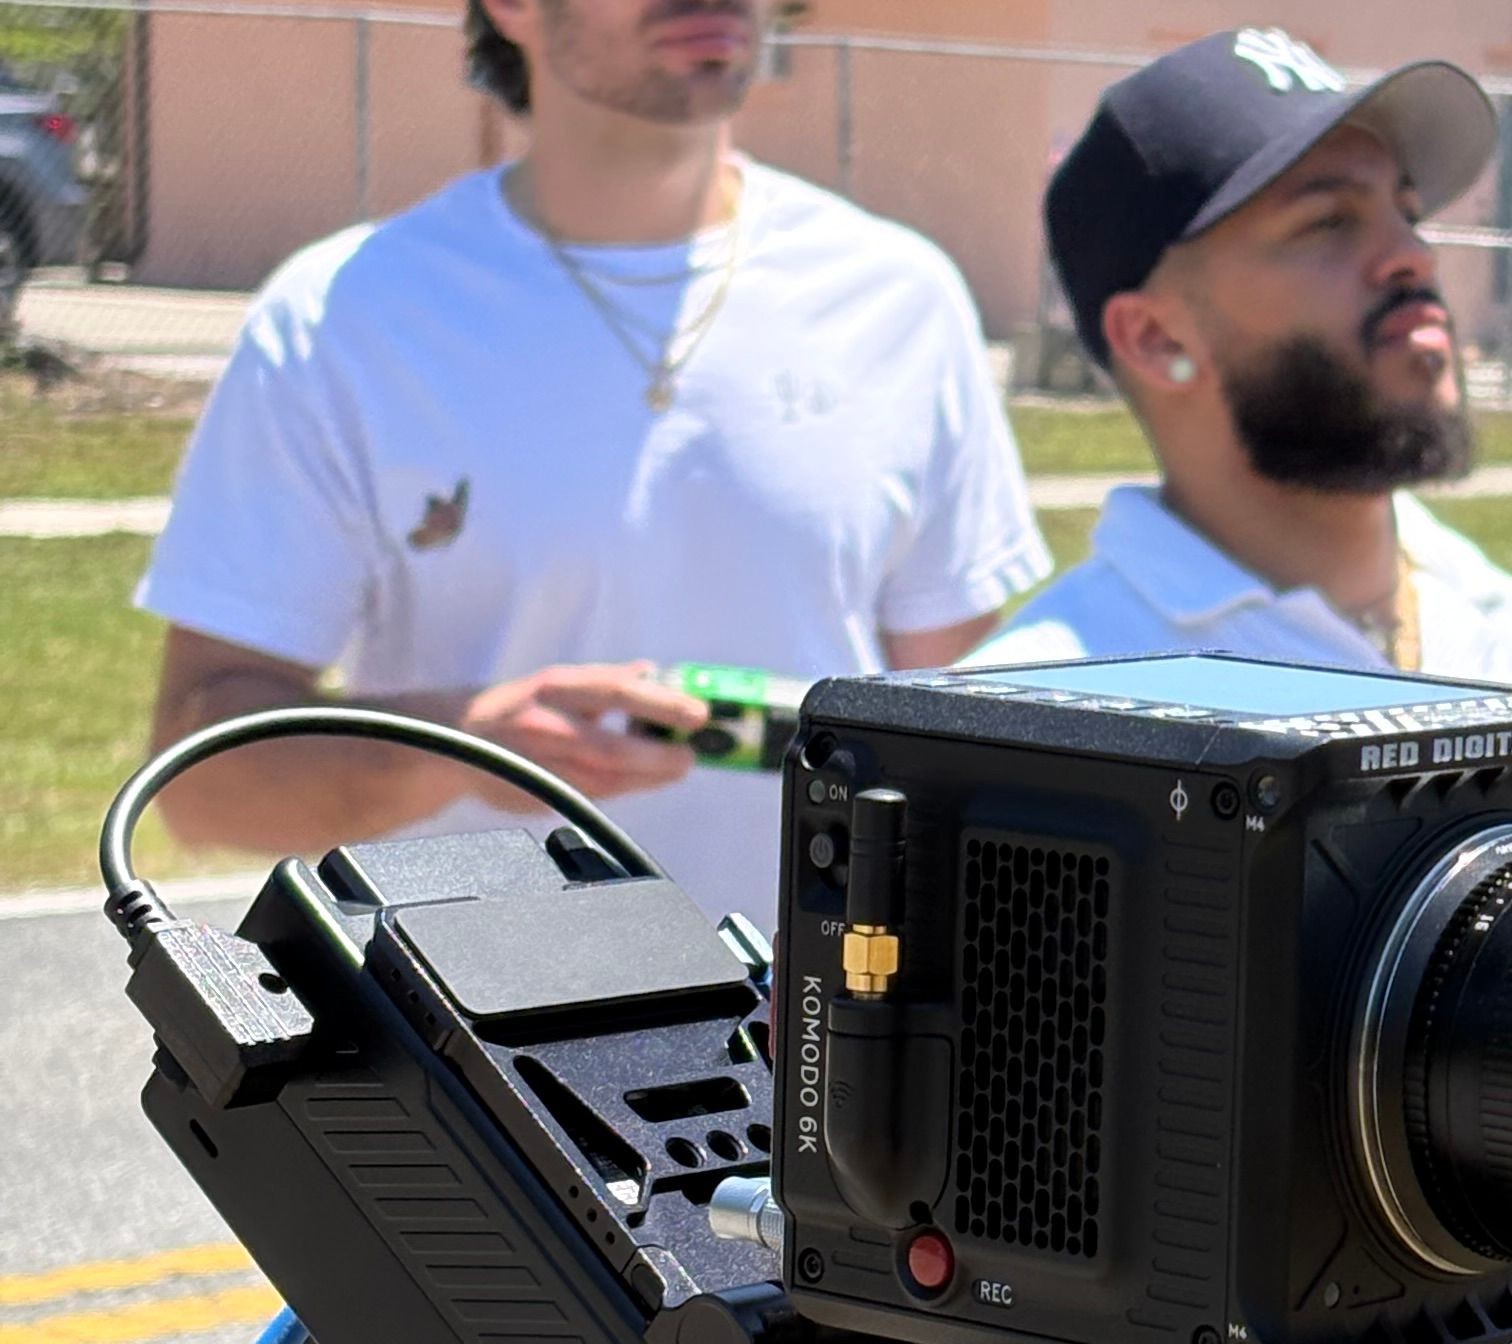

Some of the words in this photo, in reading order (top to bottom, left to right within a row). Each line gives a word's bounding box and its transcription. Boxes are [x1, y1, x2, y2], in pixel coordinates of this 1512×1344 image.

[1361, 742, 1419, 771] RED
[829, 784, 848, 802] ON
[820, 919, 846, 936] OFF
[801, 975, 822, 1108] KOMODO
[798, 1116, 818, 1153] 6K
[980, 1280, 1012, 1304] REC
